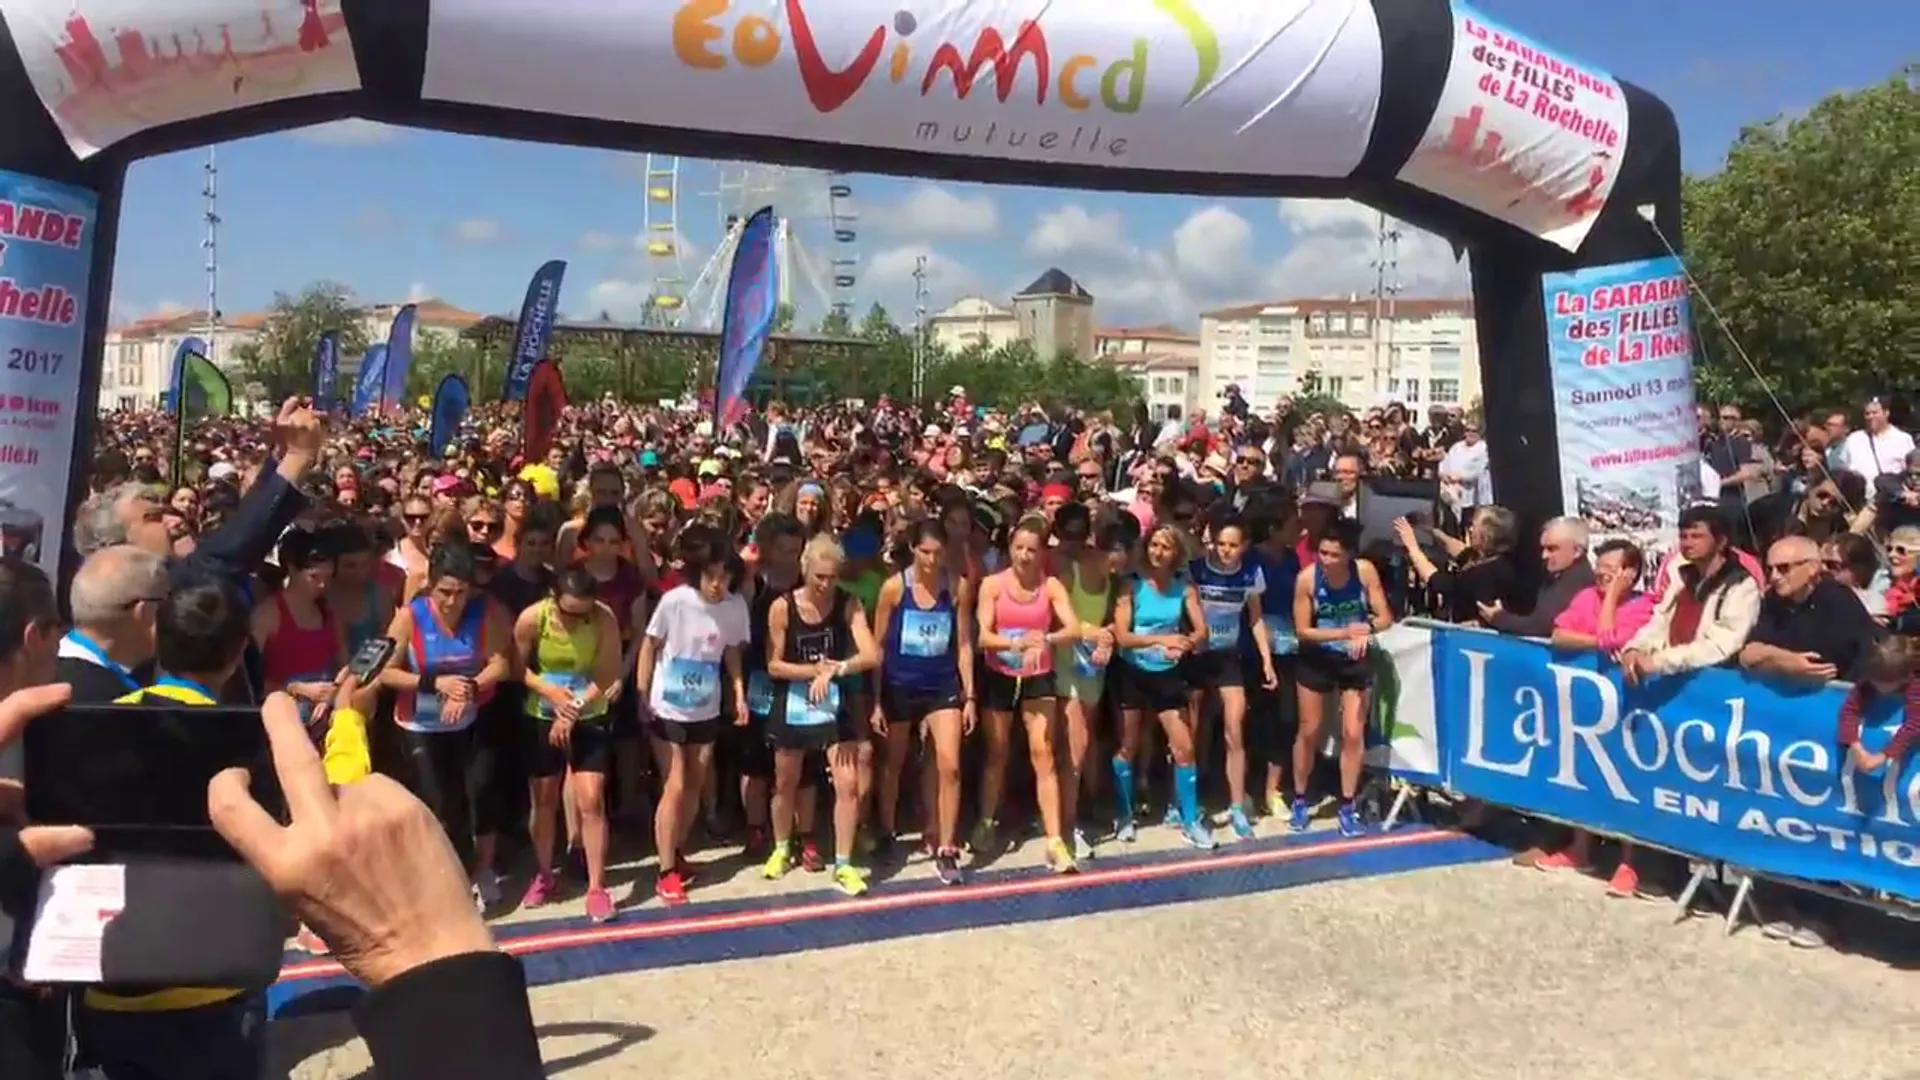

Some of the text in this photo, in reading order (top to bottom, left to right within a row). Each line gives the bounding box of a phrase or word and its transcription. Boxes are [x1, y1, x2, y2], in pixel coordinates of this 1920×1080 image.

[1465, 19, 1488, 42] La
[1472, 44, 1576, 103] des FILLES
[1478, 71, 1619, 148] de La Rochelle
[915, 121, 1129, 156] mutuelle
[1556, 293, 1585, 315] La
[1568, 306, 1679, 340] des FILLES
[7, 348, 64, 375] 2017
[1583, 346, 1612, 367] de
[1617, 339, 1644, 364] La
[1571, 383, 1642, 405] Samedi
[1645, 378, 1664, 396] 13
[1653, 788, 1720, 825] EN
